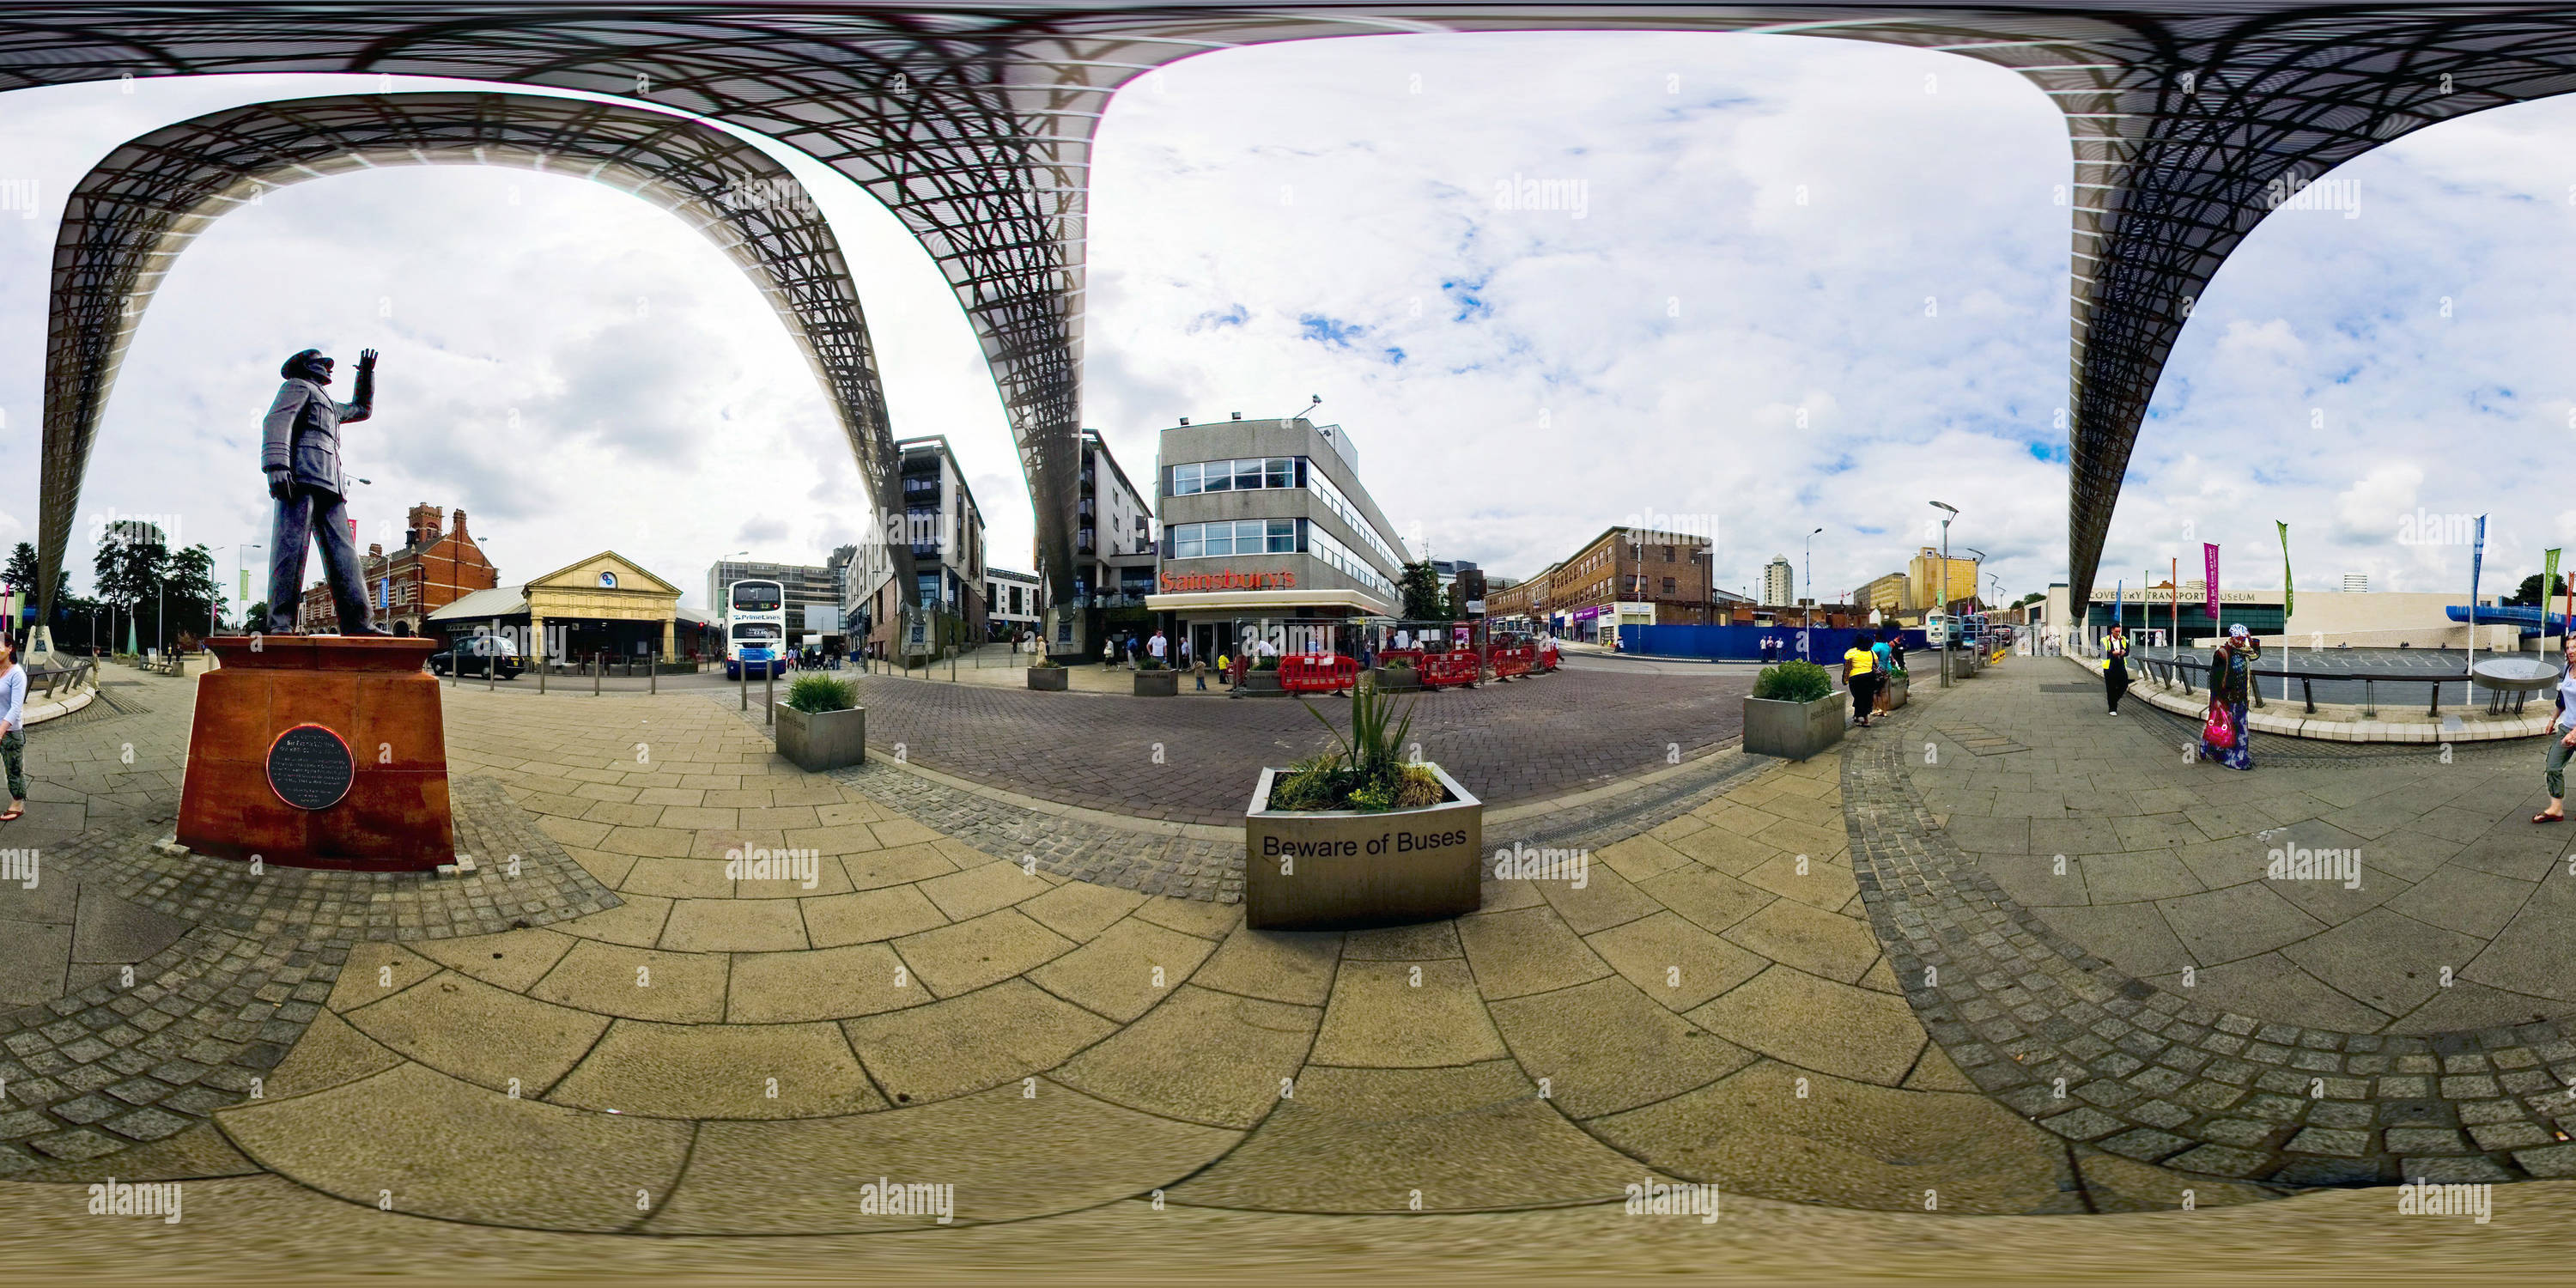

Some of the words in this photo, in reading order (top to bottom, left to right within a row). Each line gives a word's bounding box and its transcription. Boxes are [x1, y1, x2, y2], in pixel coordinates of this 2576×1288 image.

[1161, 568, 1297, 592] Sainsbury's
[2220, 592, 2255, 601] USEUM
[1263, 835, 1358, 857] Beware
[1366, 833, 1390, 855] of
[1397, 829, 1467, 853] Buses
